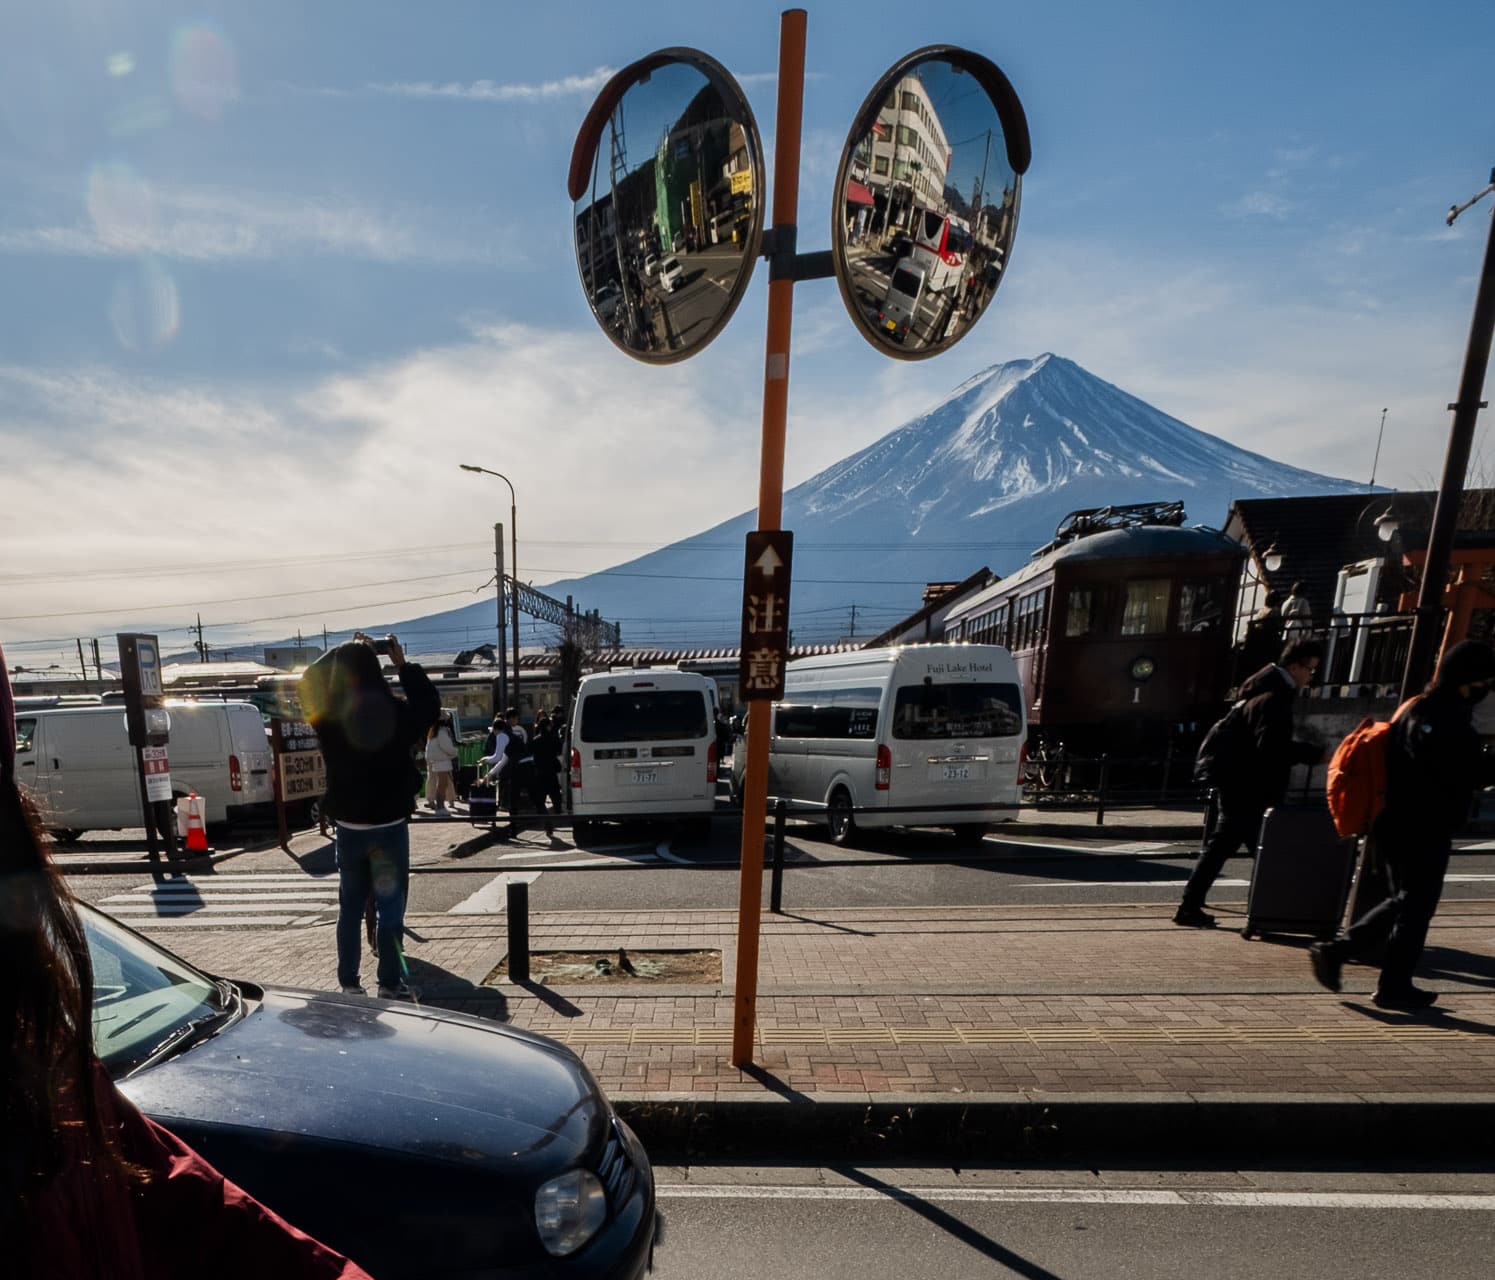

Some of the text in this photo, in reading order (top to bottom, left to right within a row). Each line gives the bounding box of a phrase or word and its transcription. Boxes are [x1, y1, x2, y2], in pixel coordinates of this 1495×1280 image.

[746, 592, 784, 689] 注意
[927, 662, 993, 674] Fuji Lake Hotel
